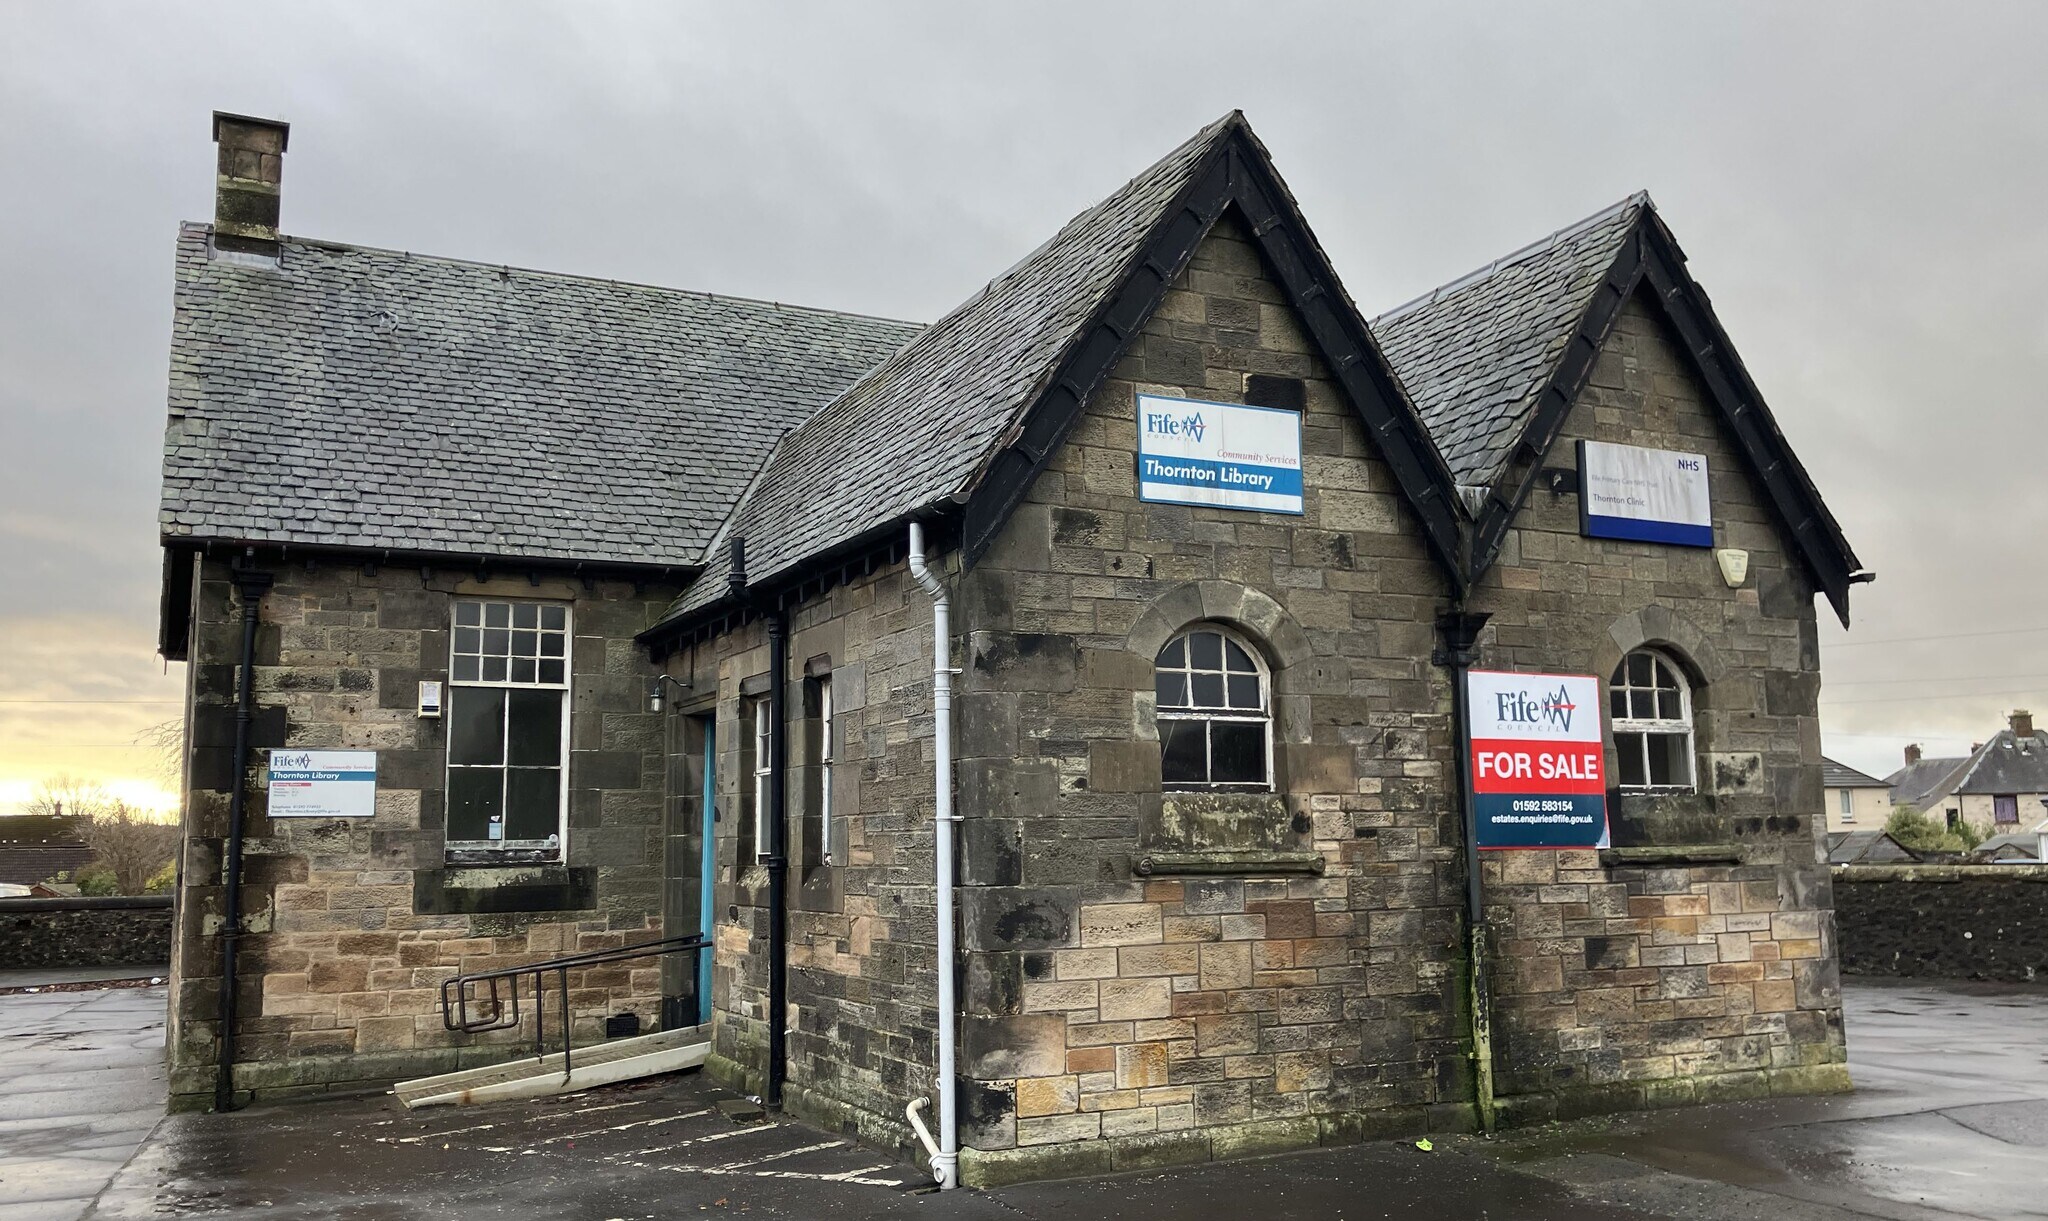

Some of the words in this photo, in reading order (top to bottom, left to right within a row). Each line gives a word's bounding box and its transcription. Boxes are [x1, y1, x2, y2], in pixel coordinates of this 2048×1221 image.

[1147, 413, 1179, 435] Fife
[1217, 449, 1264, 464] Community
[1265, 454, 1298, 465] Services
[1678, 459, 1700, 472] NHS
[1145, 460, 1216, 482] Thornton
[1220, 467, 1274, 490] Library
[1593, 493, 1625, 505] Thornton
[1626, 497, 1645, 507] Clinic
[1495, 690, 1540, 723] Fife
[1497, 723, 1562, 733] COUNCIL
[273, 755, 294, 767] Fife
[1478, 751, 1533, 779] FOR
[1538, 752, 1598, 780] SALE
[273, 771, 310, 780] Thornton
[311, 771, 340, 781] Library
[1513, 800, 1540, 812] 01592
[1542, 800, 1573, 812] 583154
[1491, 814, 1593, 826] estates.enquiries@fife.gov.uk
